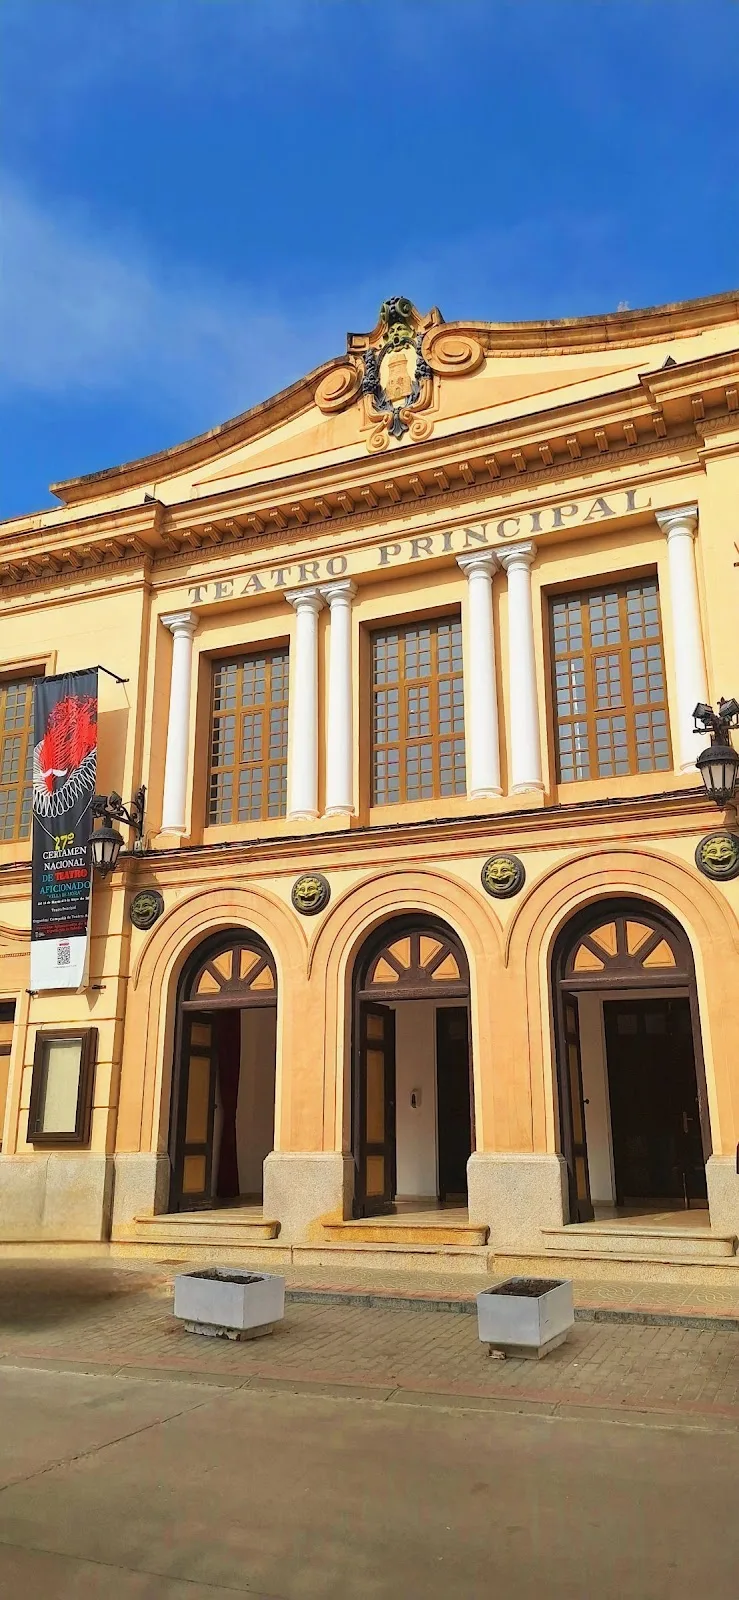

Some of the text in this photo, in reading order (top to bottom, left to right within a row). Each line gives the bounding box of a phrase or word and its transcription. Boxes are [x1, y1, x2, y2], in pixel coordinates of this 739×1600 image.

[188, 489, 653, 604] TEATRO PRINCIPAL
[43, 846, 87, 859] CERTAMEN
[44, 858, 85, 870] NACIONAL
[42, 869, 88, 883] DE TEATRO
[40, 881, 91, 894] AFICIONADO
